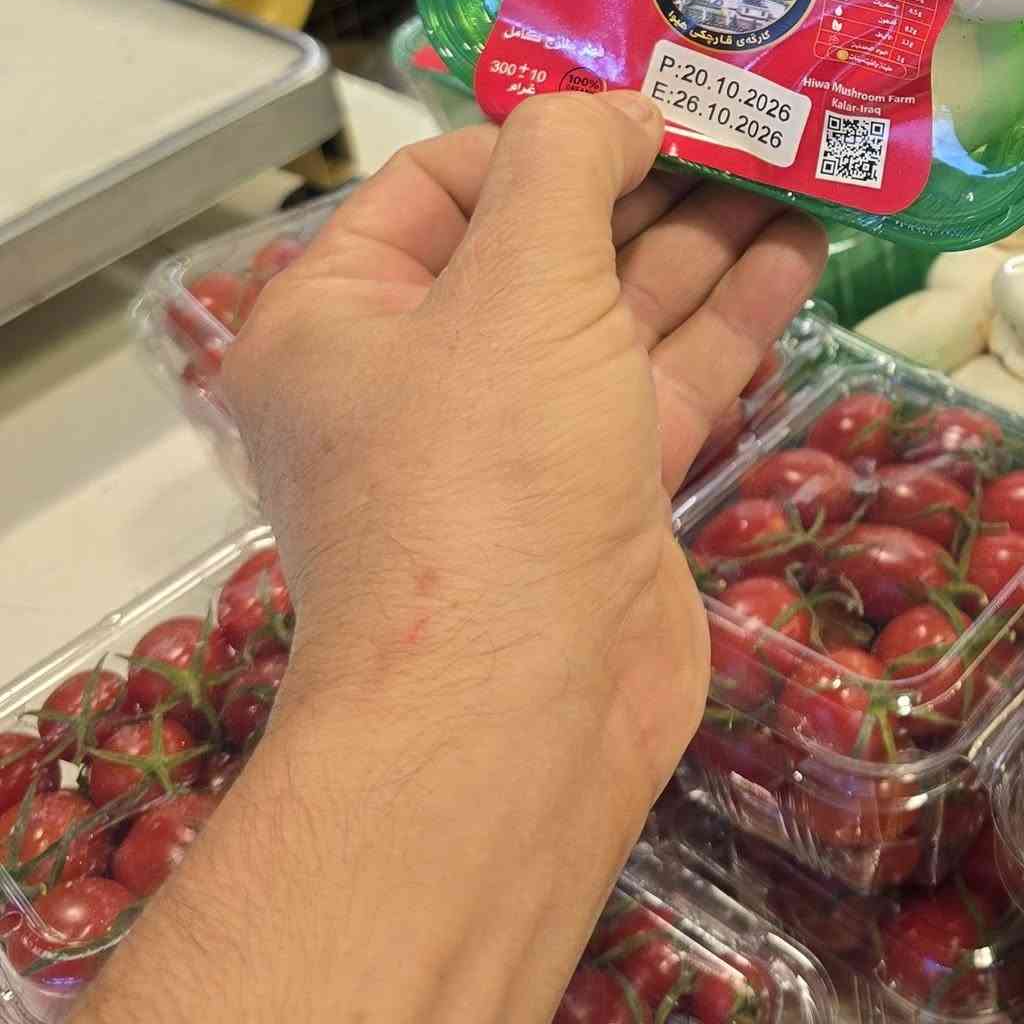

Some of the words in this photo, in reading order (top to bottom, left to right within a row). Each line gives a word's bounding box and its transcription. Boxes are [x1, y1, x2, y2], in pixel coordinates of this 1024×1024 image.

[490, 59, 516, 75] 300
[530, 69, 547, 83] 10
[568, 74, 600, 89] 100%
[506, 82, 537, 95] غرام
[659, 55, 792, 123] P:20.10.2026
[803, 78, 830, 91] Hiwa
[832, 82, 886, 104] Mushroom
[888, 95, 916, 105] Farm
[651, 80, 784, 150] E:26.10.2026
[831, 97, 882, 115] Kalar-Iraq
